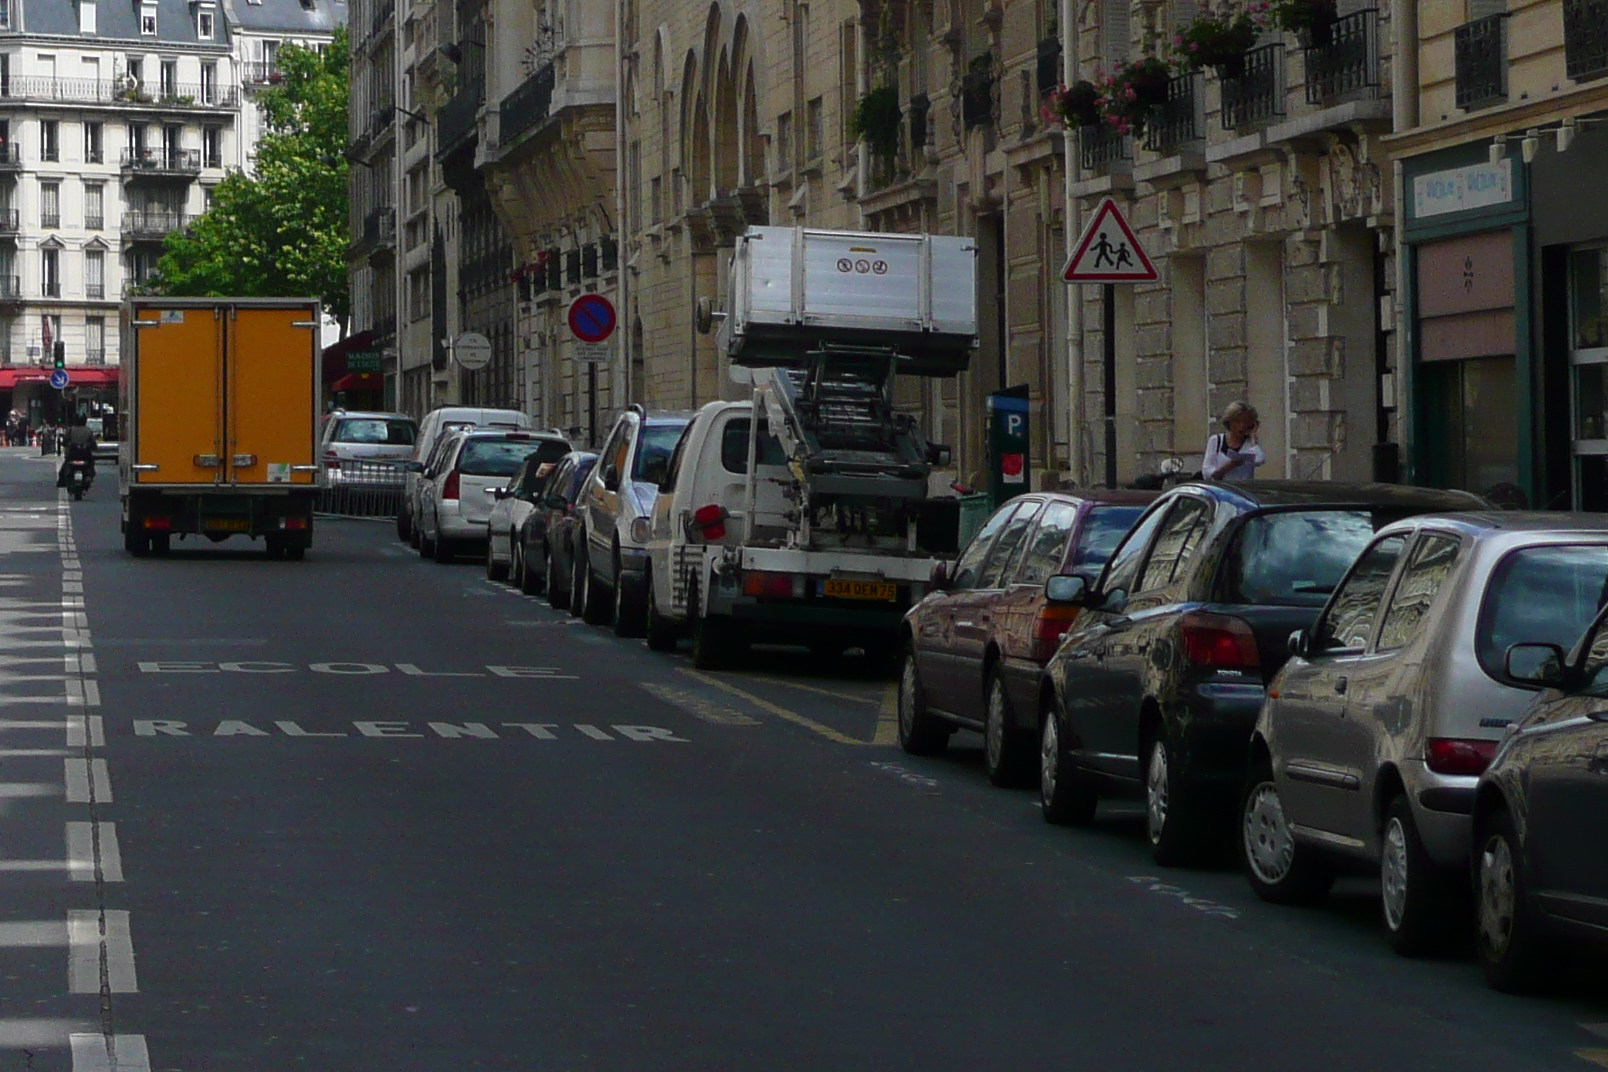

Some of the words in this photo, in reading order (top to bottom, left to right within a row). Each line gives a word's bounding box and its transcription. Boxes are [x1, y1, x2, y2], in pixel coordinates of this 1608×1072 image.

[1007, 414, 1022, 435] P
[828, 581, 850, 595] 334
[879, 584, 895, 598] 75
[136, 660, 581, 680] ECOLE
[130, 717, 692, 743] RALENTIR
